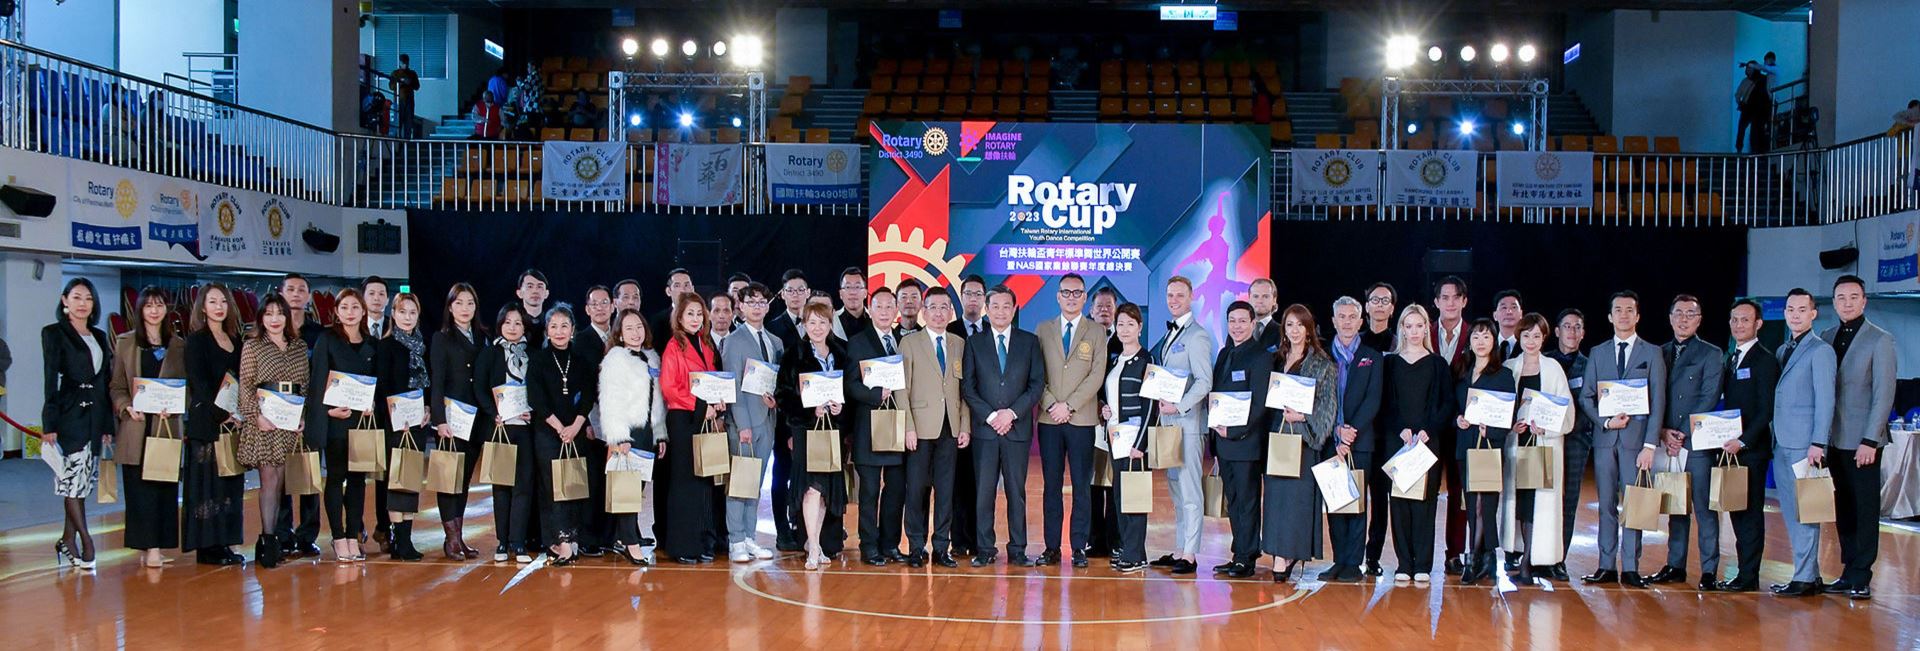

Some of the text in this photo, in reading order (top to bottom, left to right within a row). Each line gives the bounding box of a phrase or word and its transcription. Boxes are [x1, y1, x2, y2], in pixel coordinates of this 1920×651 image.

[882, 134, 922, 149] Rotary
[985, 133, 1023, 141] IMAGINE
[985, 142, 1016, 150] ROTARY
[563, 145, 613, 167] ROTARY CLUB
[787, 154, 824, 169] Rotary
[878, 150, 923, 159] District 3490
[1311, 150, 1364, 173] ROTARY CLUB
[1408, 150, 1461, 173] ROTARY CLUB
[783, 168, 825, 177] District 3490
[88, 181, 114, 200] Rotary
[160, 193, 180, 207] Rotary
[1008, 174, 1137, 212] Rotary
[210, 191, 242, 215] ROTARY CLUB
[261, 198, 290, 219] ROTARY CLUB
[1042, 199, 1117, 235] Cup
